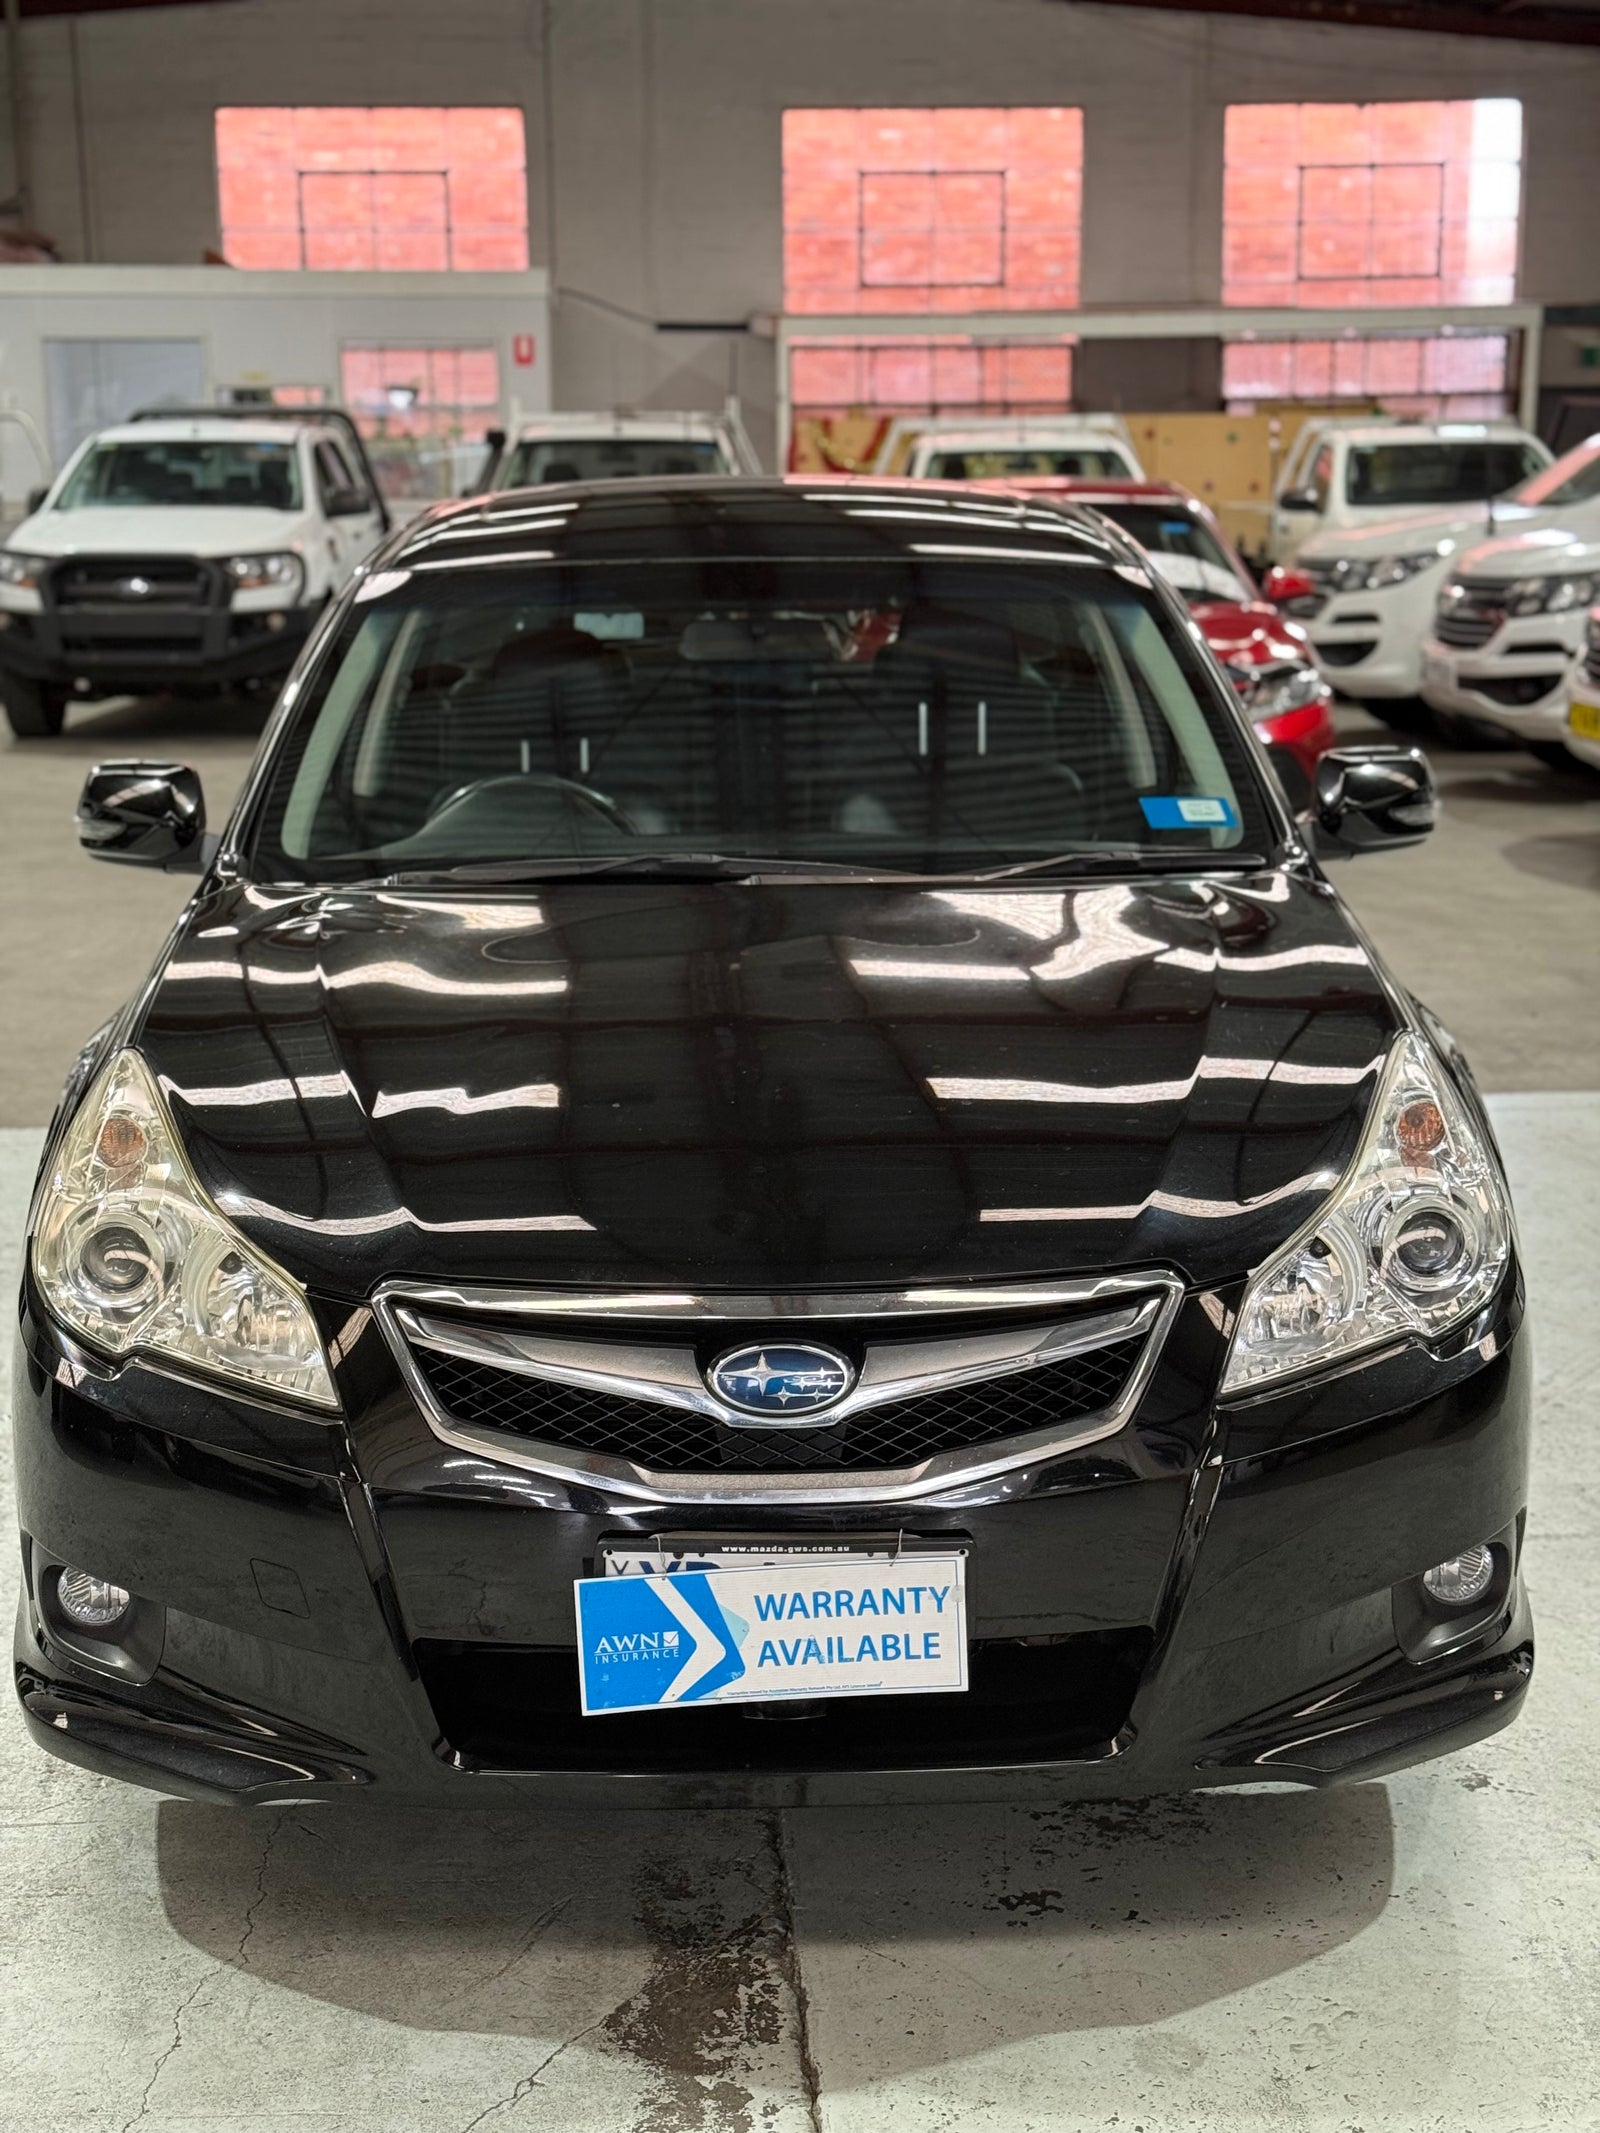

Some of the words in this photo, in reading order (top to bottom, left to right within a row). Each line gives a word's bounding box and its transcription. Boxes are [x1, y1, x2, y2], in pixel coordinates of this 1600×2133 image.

[721, 1545, 850, 1554] www.mazda.gws.com.au
[753, 1585, 950, 1622] WARRANTY
[594, 1631, 660, 1654] AWN
[757, 1632, 941, 1668] AVAILABLE
[595, 1648, 680, 1665] INSURANCE
